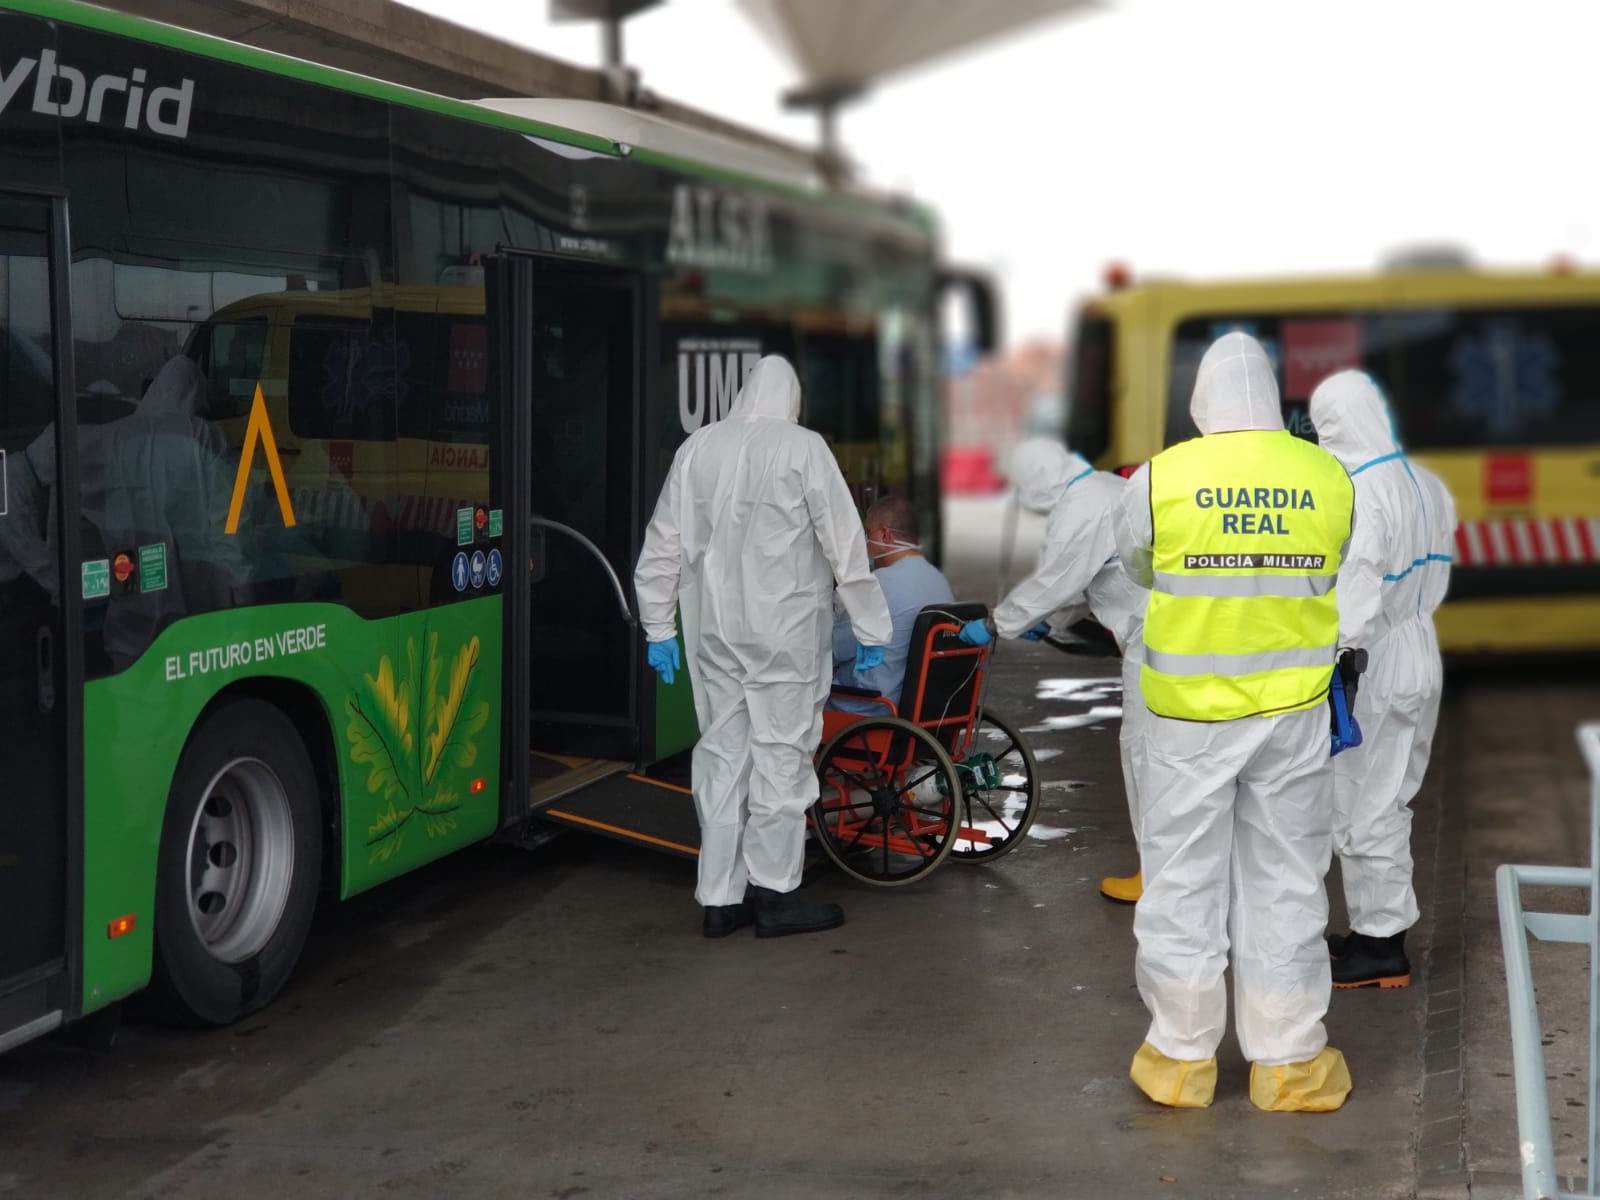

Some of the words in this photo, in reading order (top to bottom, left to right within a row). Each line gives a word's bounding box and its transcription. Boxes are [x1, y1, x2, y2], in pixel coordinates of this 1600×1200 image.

[1195, 487, 1315, 510] GUARDIA
[1222, 513, 1290, 535] REAL
[1187, 554, 1254, 568] POLICÍA
[1263, 555, 1323, 568] MILITAR
[165, 655, 187, 681] EL
[189, 641, 252, 676] FUTURO
[254, 636, 275, 662] EN
[275, 624, 326, 656] VERDE
